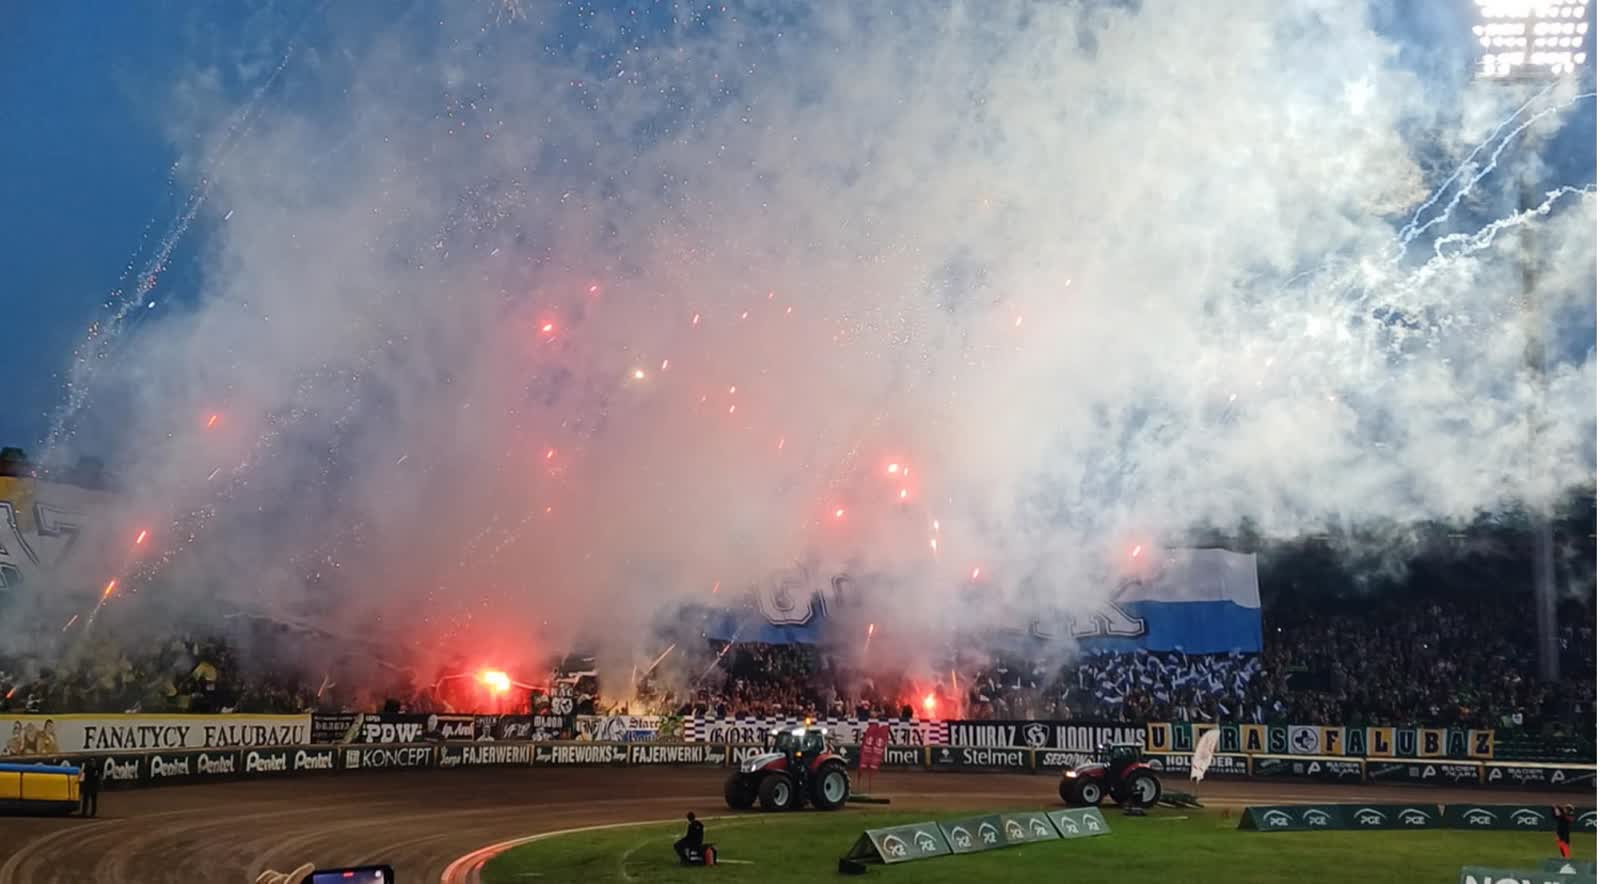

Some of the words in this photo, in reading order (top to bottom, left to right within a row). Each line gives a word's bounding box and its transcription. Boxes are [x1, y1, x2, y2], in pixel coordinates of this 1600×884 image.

[83, 725, 191, 750] FANATYCY
[203, 724, 305, 748] FALUBAZU
[365, 723, 416, 744] PDW
[1151, 726, 1287, 752] ULRAS
[1325, 729, 1490, 755] FALUBAZ
[197, 752, 235, 775] Pentel
[246, 751, 286, 772] Pentel
[294, 749, 333, 769] Pentel
[362, 747, 432, 768] KONCEPT
[462, 745, 529, 764] FAJERWERKI
[551, 745, 612, 764] FIREWORKS
[632, 745, 702, 764] FAJERWERKI
[884, 748, 918, 765] lmet
[963, 748, 1023, 766] Stelmet
[102, 756, 139, 780] Pentel
[150, 755, 190, 778] Pentel
[1270, 817, 1288, 826] PGE
[1309, 816, 1327, 825] PGE
[1360, 815, 1381, 825] PGE
[1405, 815, 1425, 825] PGE
[1470, 816, 1491, 825] PGE
[1517, 816, 1538, 825] PGE
